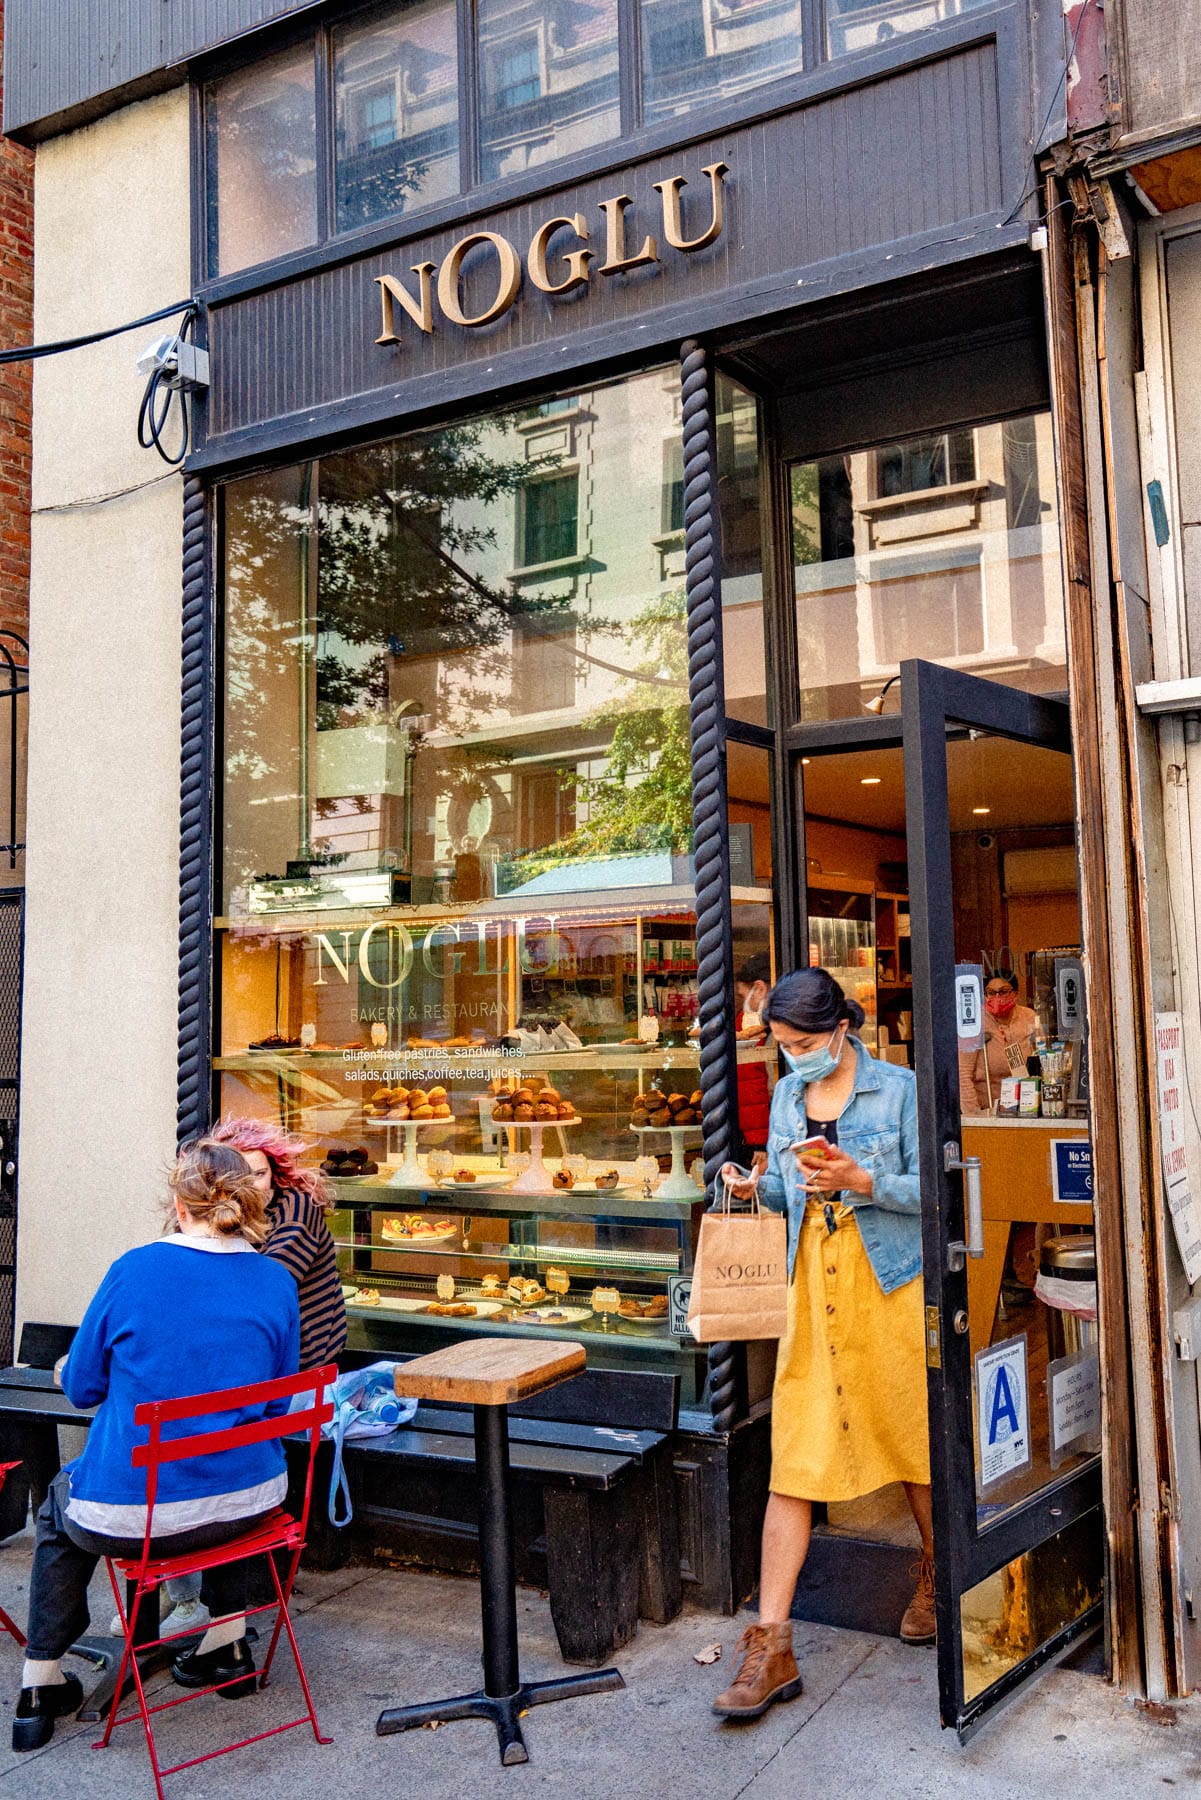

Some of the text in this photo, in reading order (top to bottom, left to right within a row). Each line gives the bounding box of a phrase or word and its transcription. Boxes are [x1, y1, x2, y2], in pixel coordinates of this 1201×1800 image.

[374, 161, 730, 346] NOGLU
[313, 915, 560, 988] NOGLU
[350, 1002, 523, 1022] BAKERY & RESTAURAN
[404, 1046, 450, 1062] pastries,
[455, 1044, 526, 1059] sandwiches,
[1069, 1151, 1080, 1161] No
[716, 1264, 777, 1280] NOGLU
[675, 1314, 685, 1323] NO
[989, 1366, 1019, 1445] A
